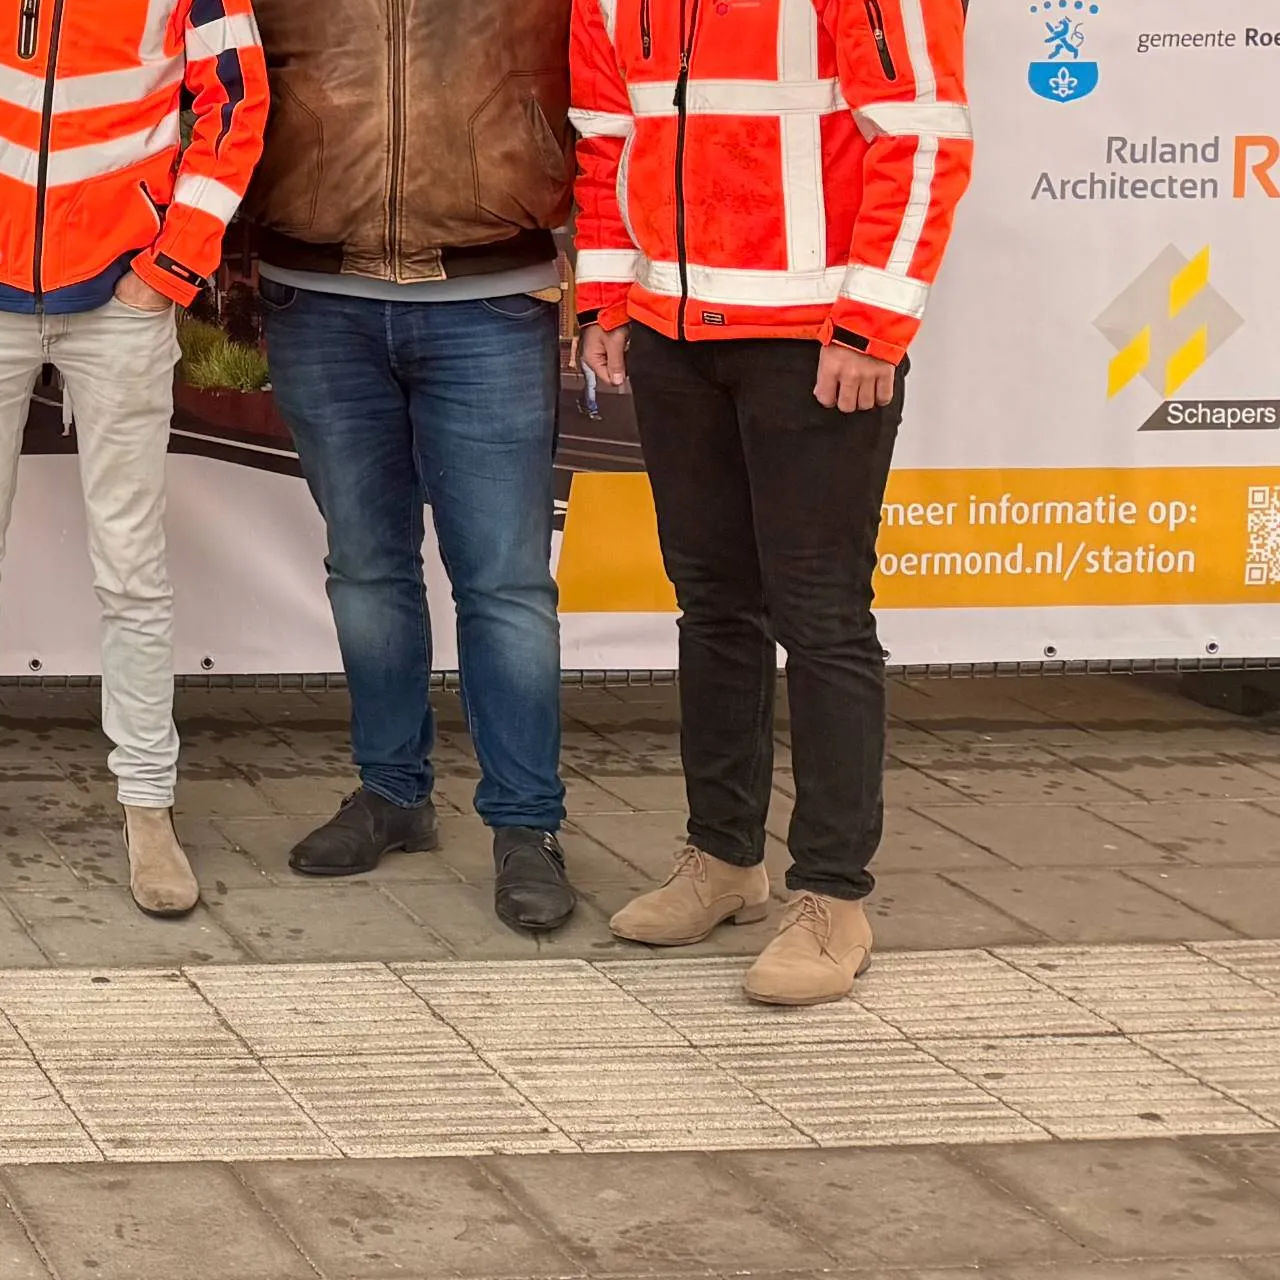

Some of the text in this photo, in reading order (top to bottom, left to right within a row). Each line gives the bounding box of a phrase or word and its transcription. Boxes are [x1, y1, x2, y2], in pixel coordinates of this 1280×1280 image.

[1137, 30, 1236, 53] gemeente
[1106, 136, 1220, 164] Ruland
[1030, 172, 1218, 200] Architecten
[1166, 402, 1277, 429] Schapers
[969, 493, 1137, 526] informatie
[1148, 501, 1197, 531] op:
